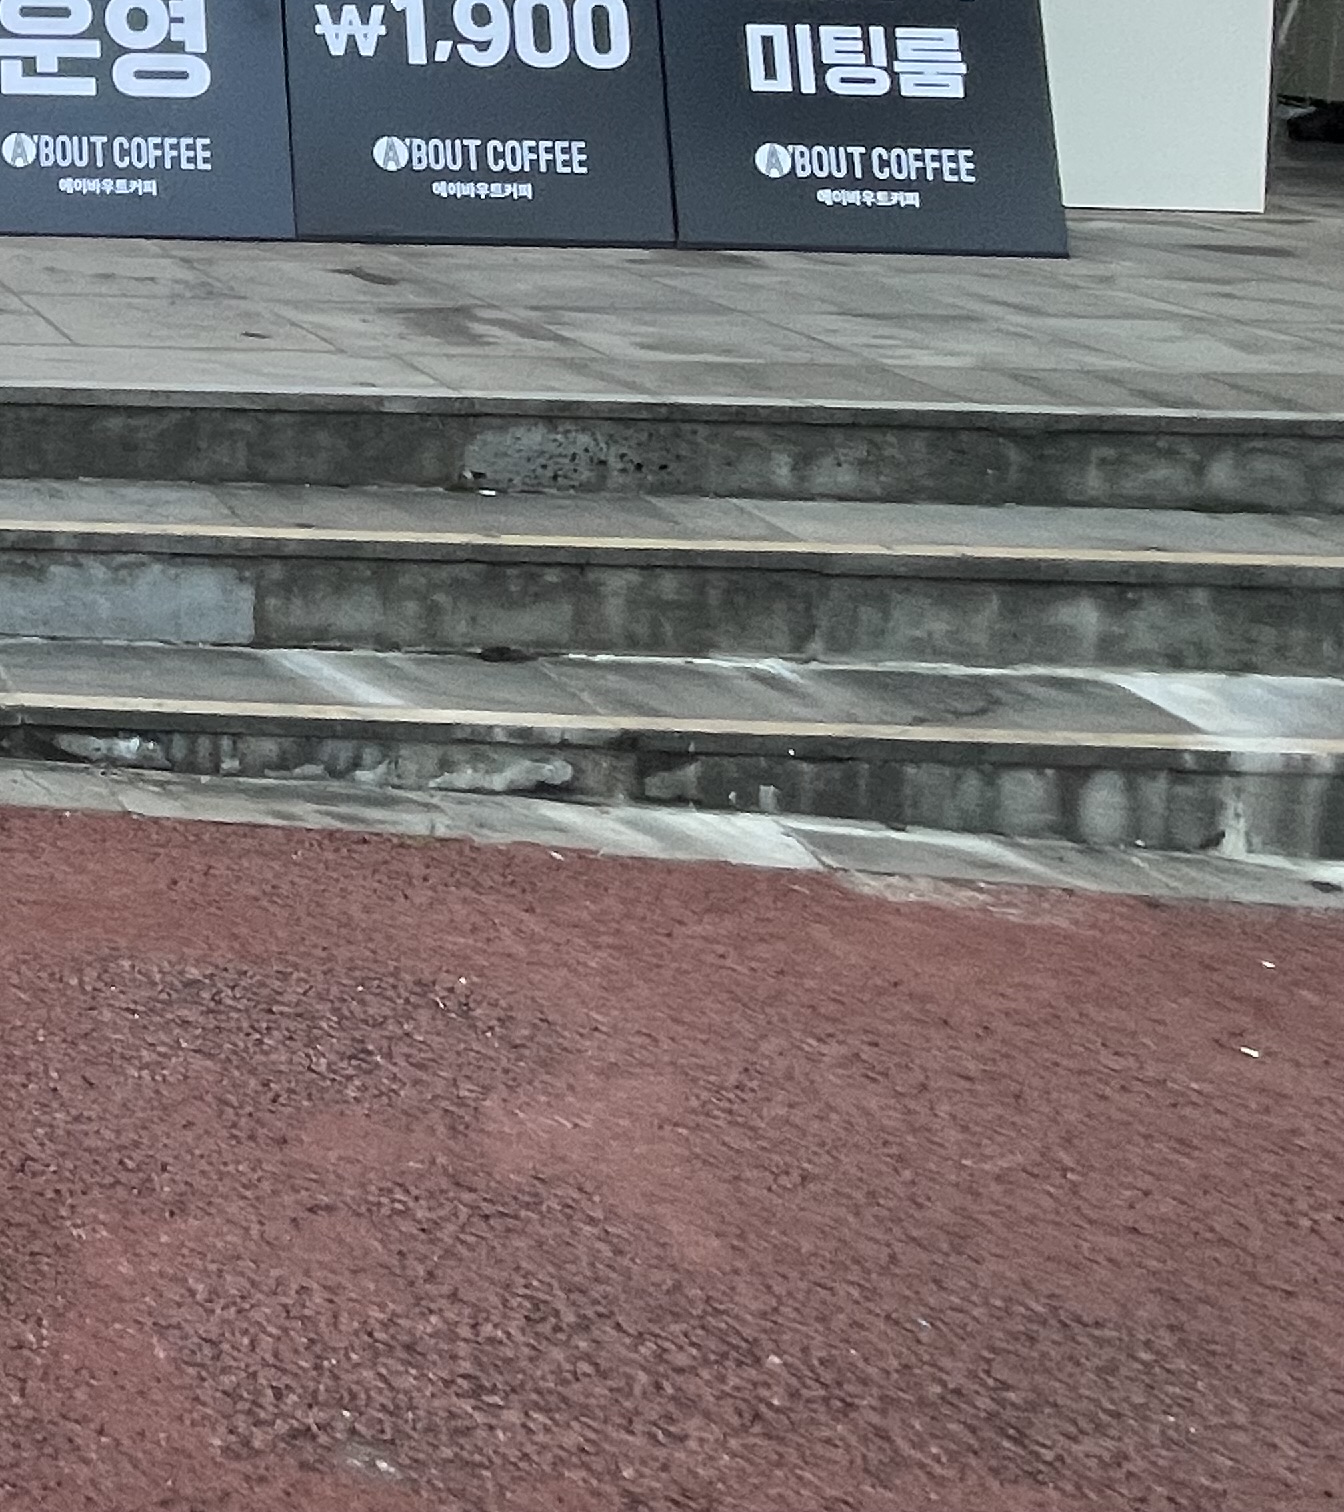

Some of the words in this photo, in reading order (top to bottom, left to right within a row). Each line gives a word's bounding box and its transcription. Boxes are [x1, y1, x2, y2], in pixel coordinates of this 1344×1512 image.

[744, 22, 968, 99] 미팅룸
[112, 135, 212, 171] COFFEE
[486, 139, 589, 174] COFFEE
[871, 147, 977, 183] COFFEE
